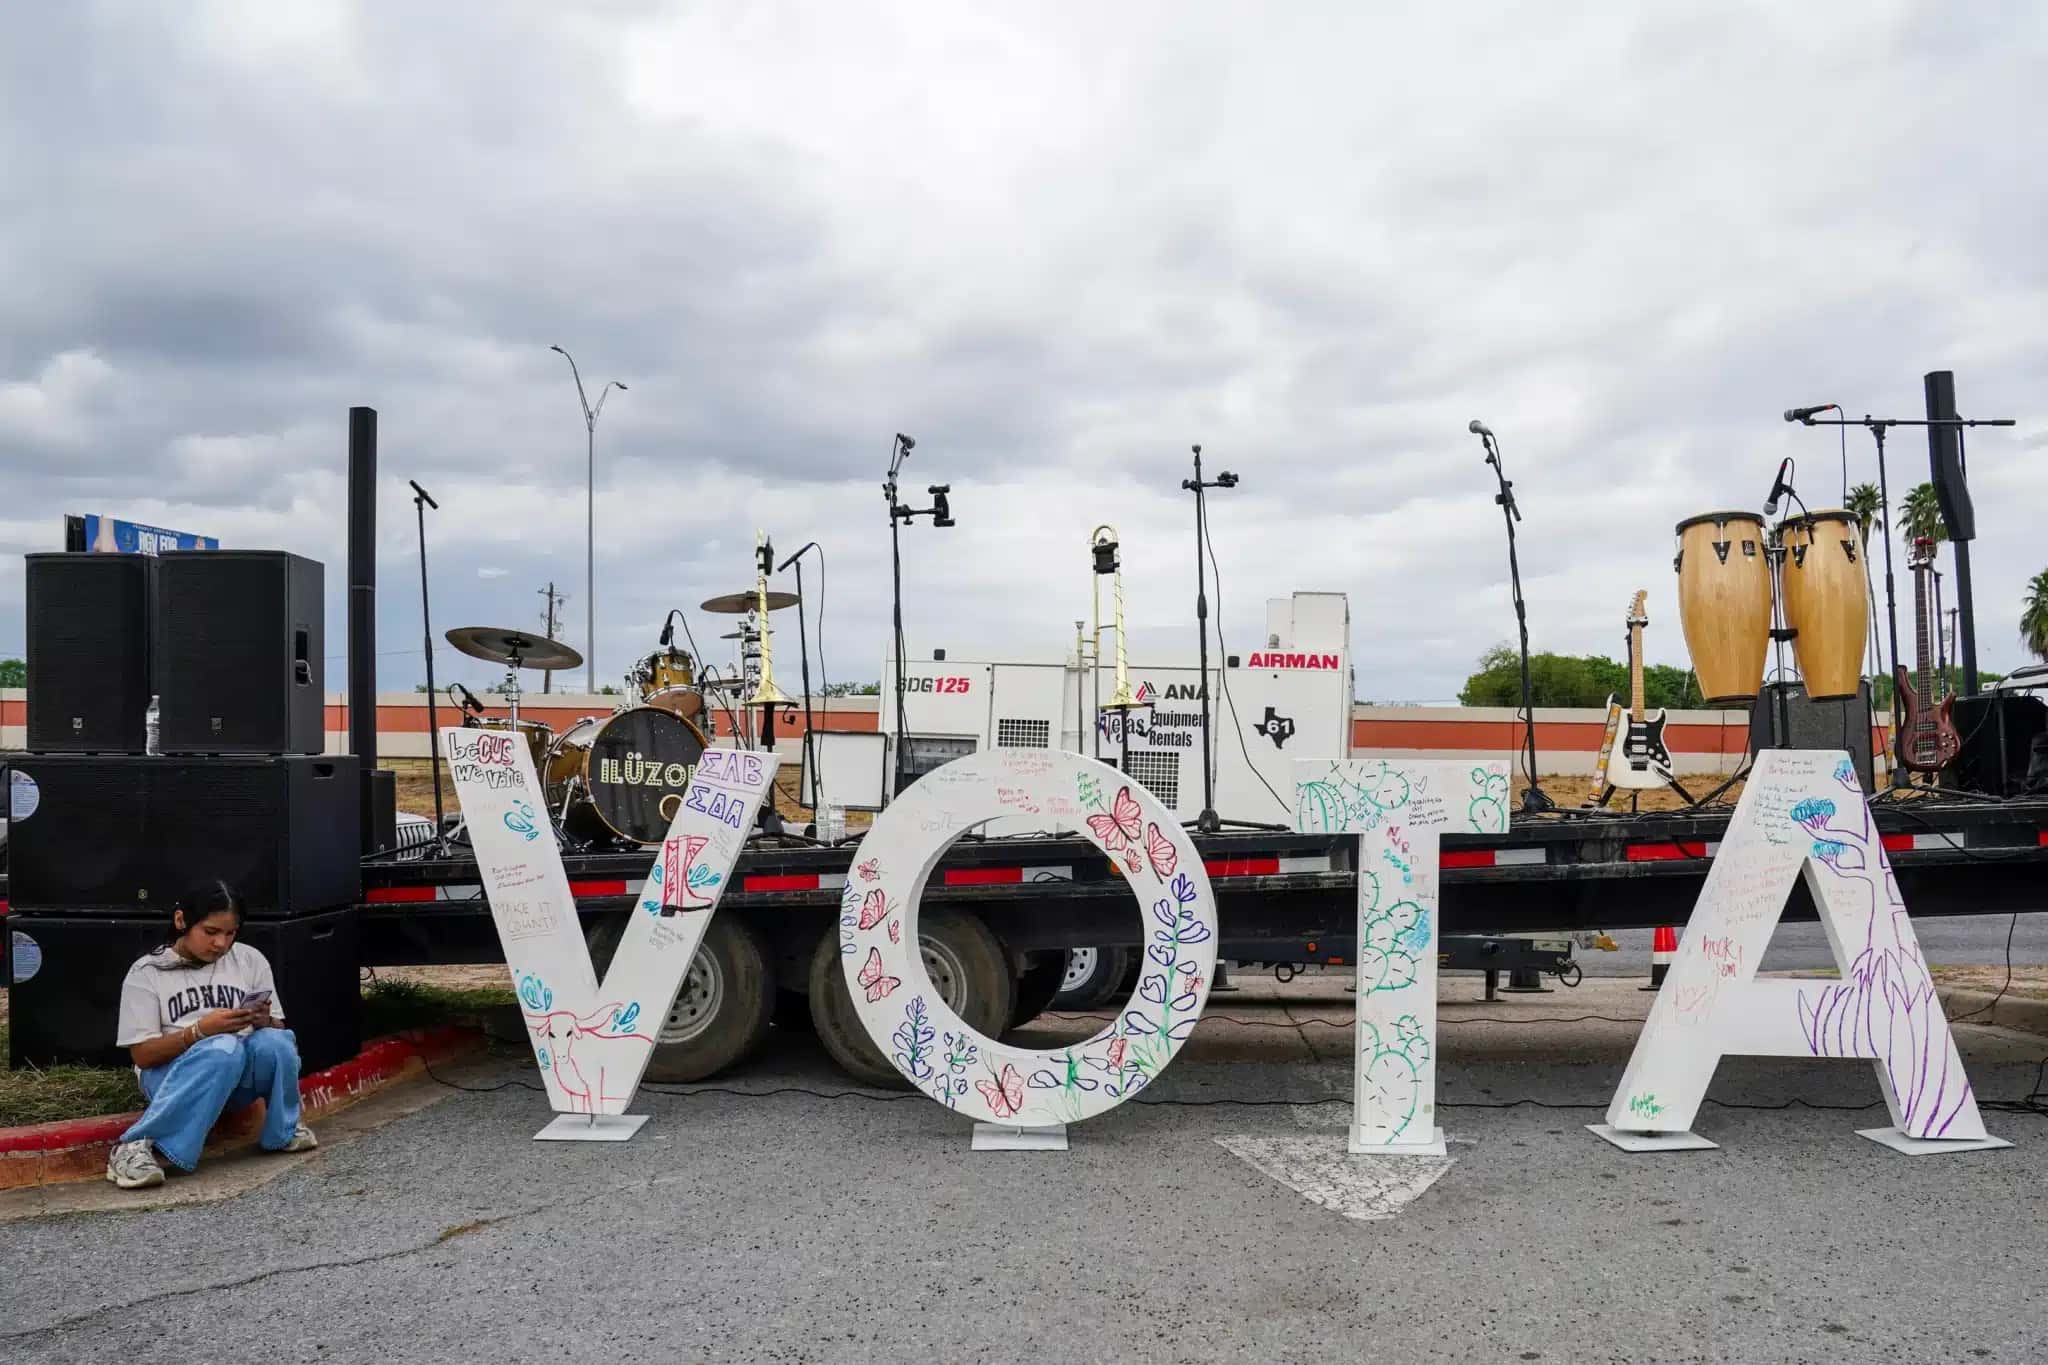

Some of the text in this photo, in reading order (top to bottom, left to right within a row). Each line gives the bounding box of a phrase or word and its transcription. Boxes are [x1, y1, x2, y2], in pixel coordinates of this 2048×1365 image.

[1248, 653, 1338, 669] AIRMAN
[1267, 719, 1290, 735] 61
[1149, 730, 1192, 747] Rentals
[168, 987, 200, 1023] OLD
